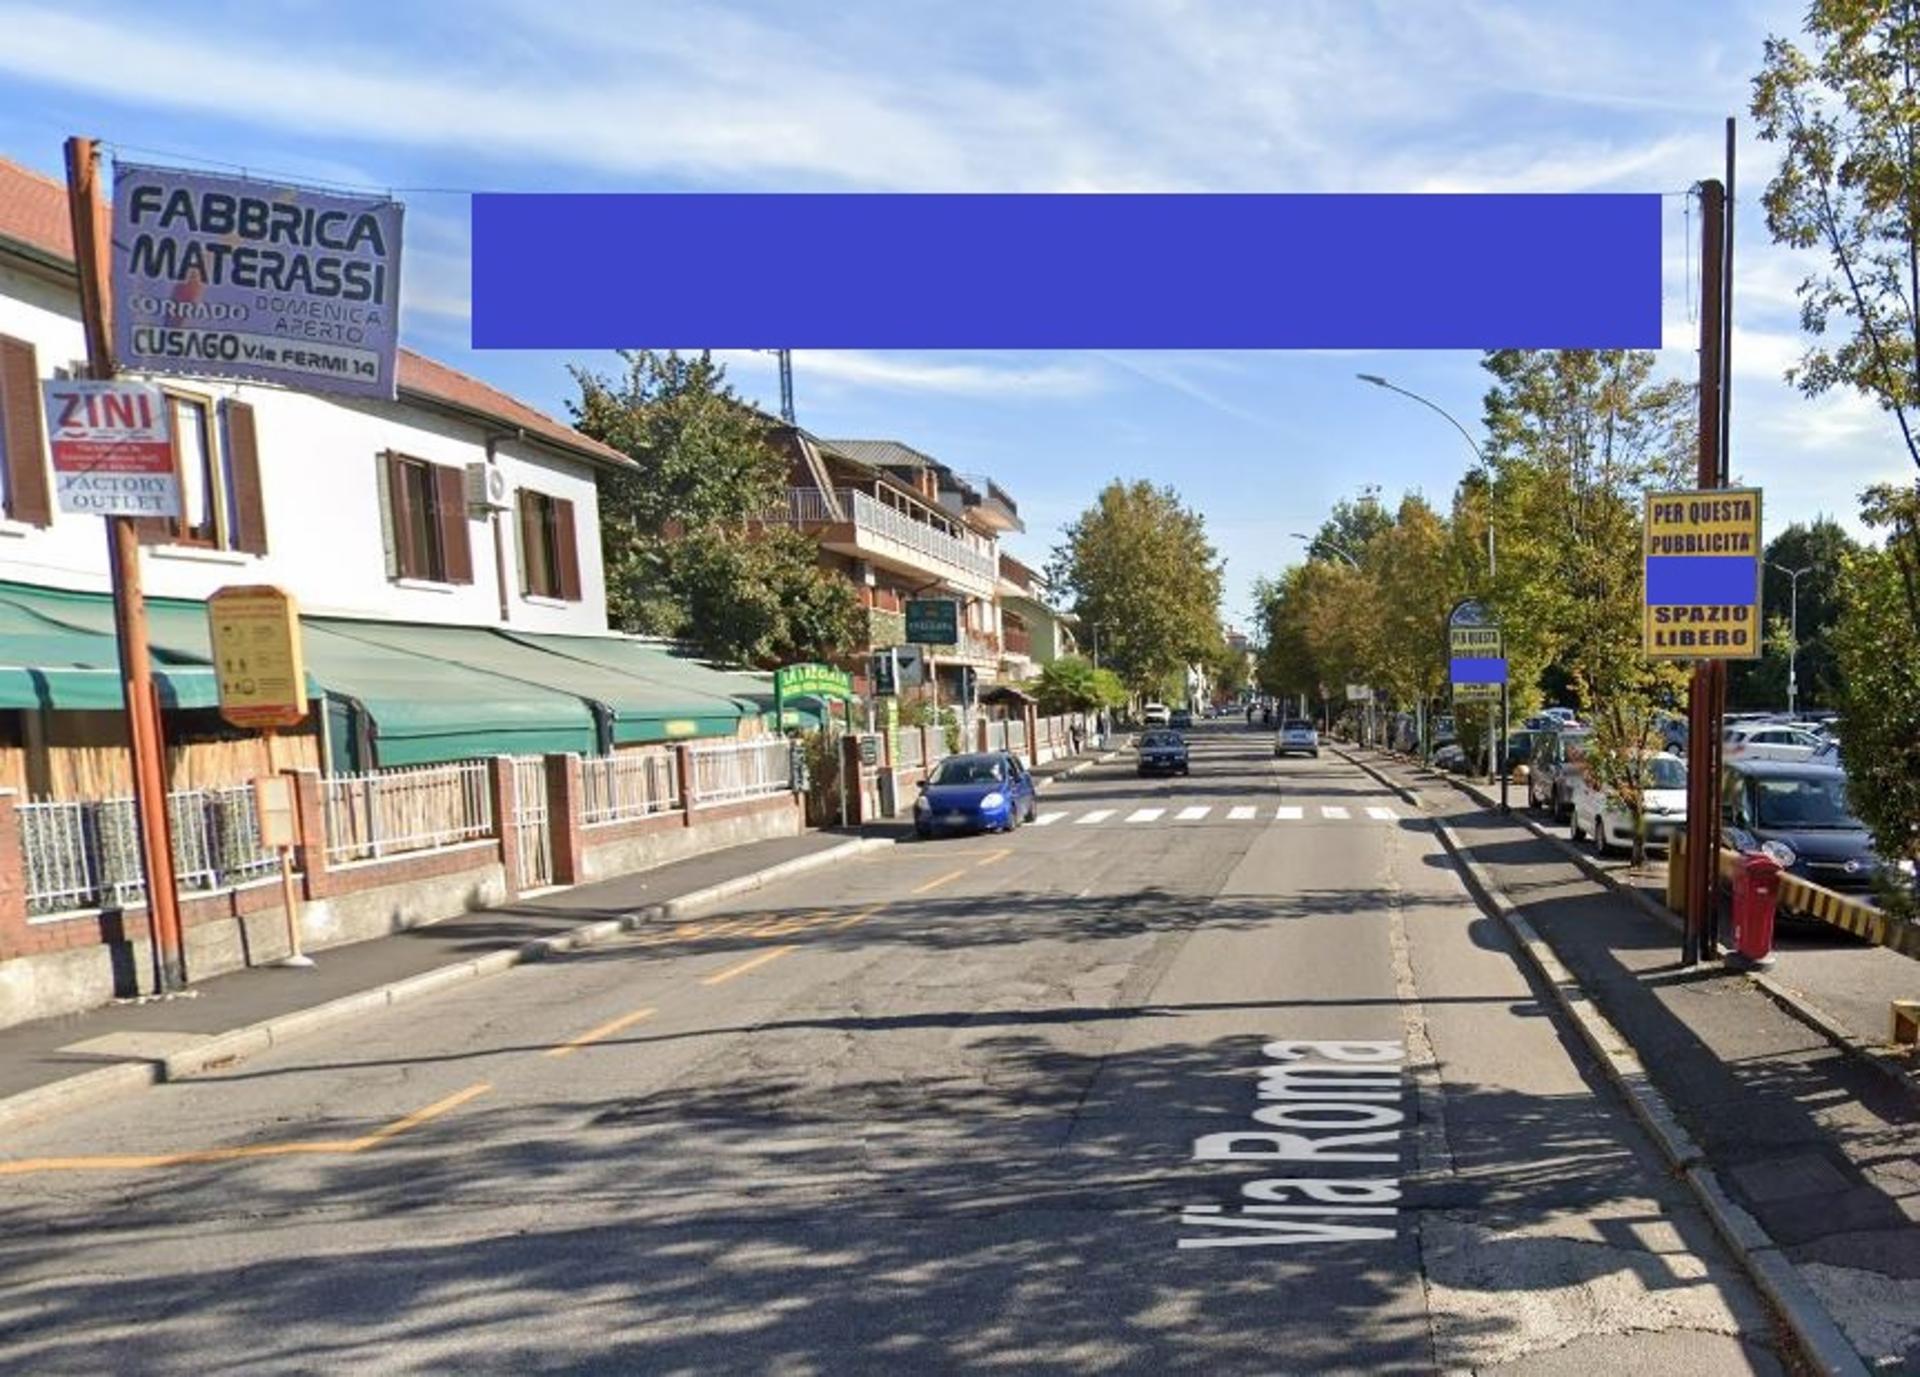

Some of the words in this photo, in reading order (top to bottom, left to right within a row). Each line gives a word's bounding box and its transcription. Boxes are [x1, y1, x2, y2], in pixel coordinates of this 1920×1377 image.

[129, 186, 387, 257] FABBRICA
[128, 233, 386, 305] MATERASSI
[130, 298, 249, 322] CORRADO
[255, 295, 382, 326] DOMENICA
[275, 317, 364, 344] APERTO
[133, 327, 240, 361] CUSAGO
[281, 350, 348, 374] FERMI
[352, 360, 376, 378] 14
[52, 393, 152, 428] ZINI
[65, 476, 168, 492] FACTORY
[72, 495, 165, 510] OUTLET
[1654, 502, 1684, 525] PER
[1690, 500, 1752, 525] QUESTA
[1655, 606, 1748, 624] SPAZIO
[1655, 629, 1748, 647] LIBERO
[1191, 1040, 1406, 1162] Roma
[1177, 1178, 1403, 1249] Via
